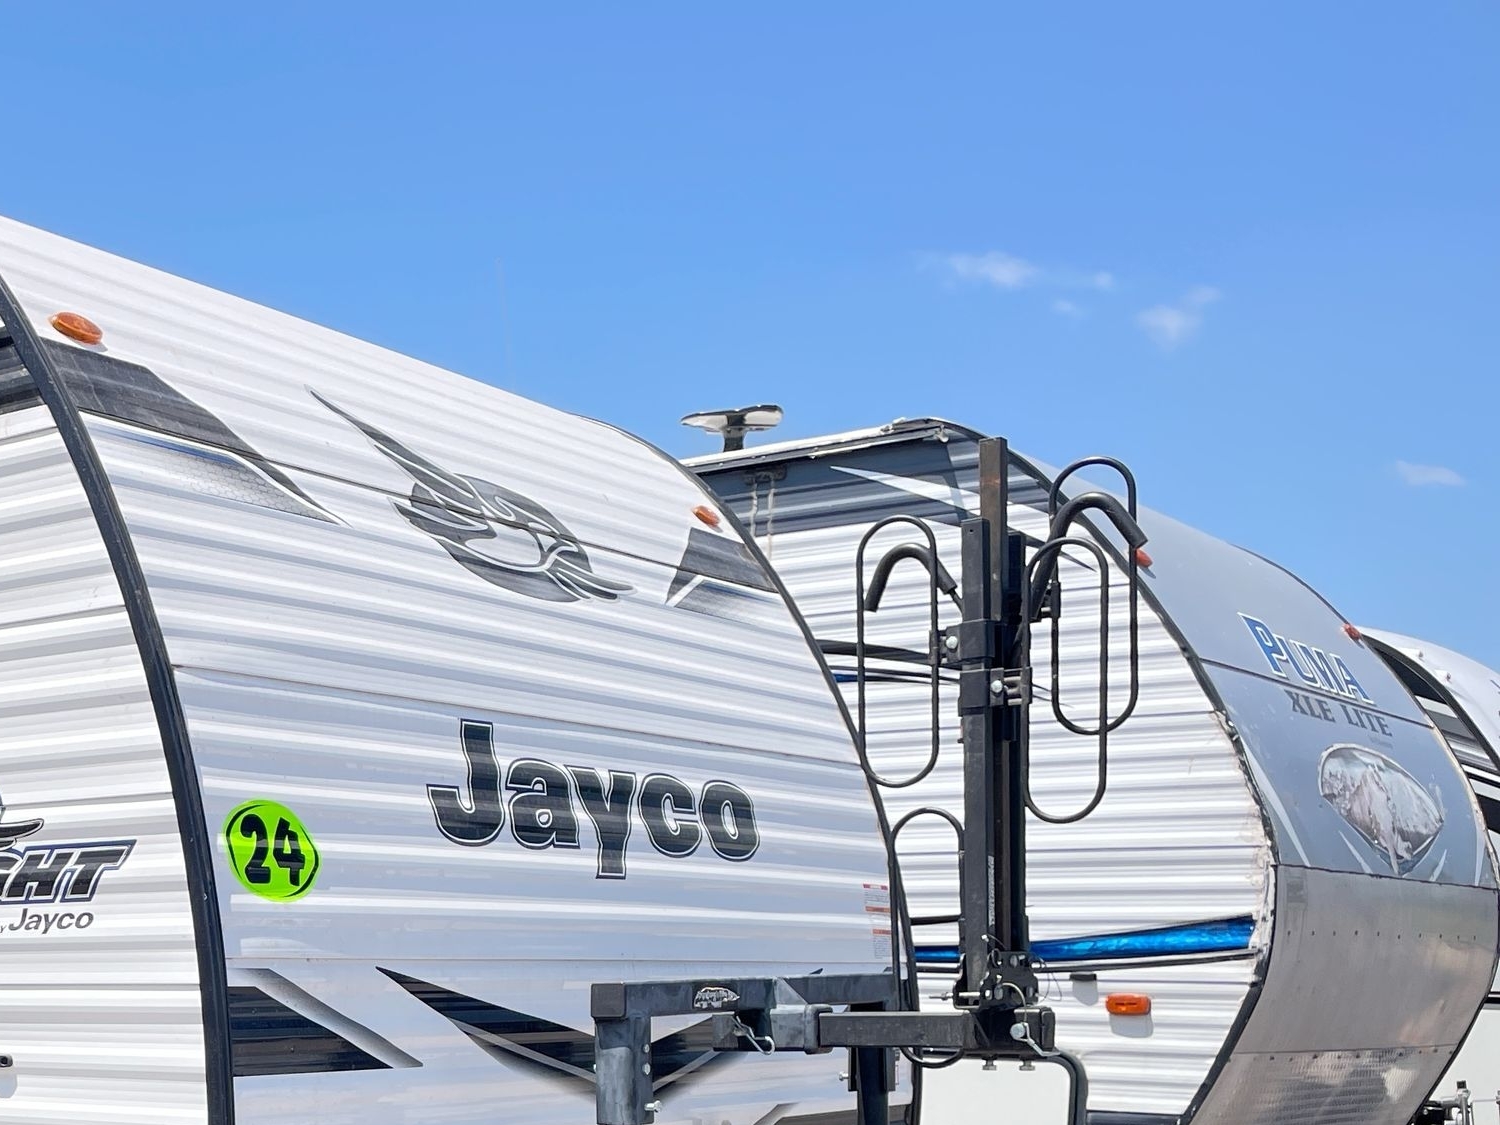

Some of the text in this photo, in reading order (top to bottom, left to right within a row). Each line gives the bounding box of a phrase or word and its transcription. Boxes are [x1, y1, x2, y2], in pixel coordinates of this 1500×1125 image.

[1237, 612, 1375, 704] PUMA
[1284, 689, 1393, 737] XLE LITE
[426, 718, 760, 880] Jayco
[241, 813, 305, 887] 24
[8, 908, 94, 934] Jayco
